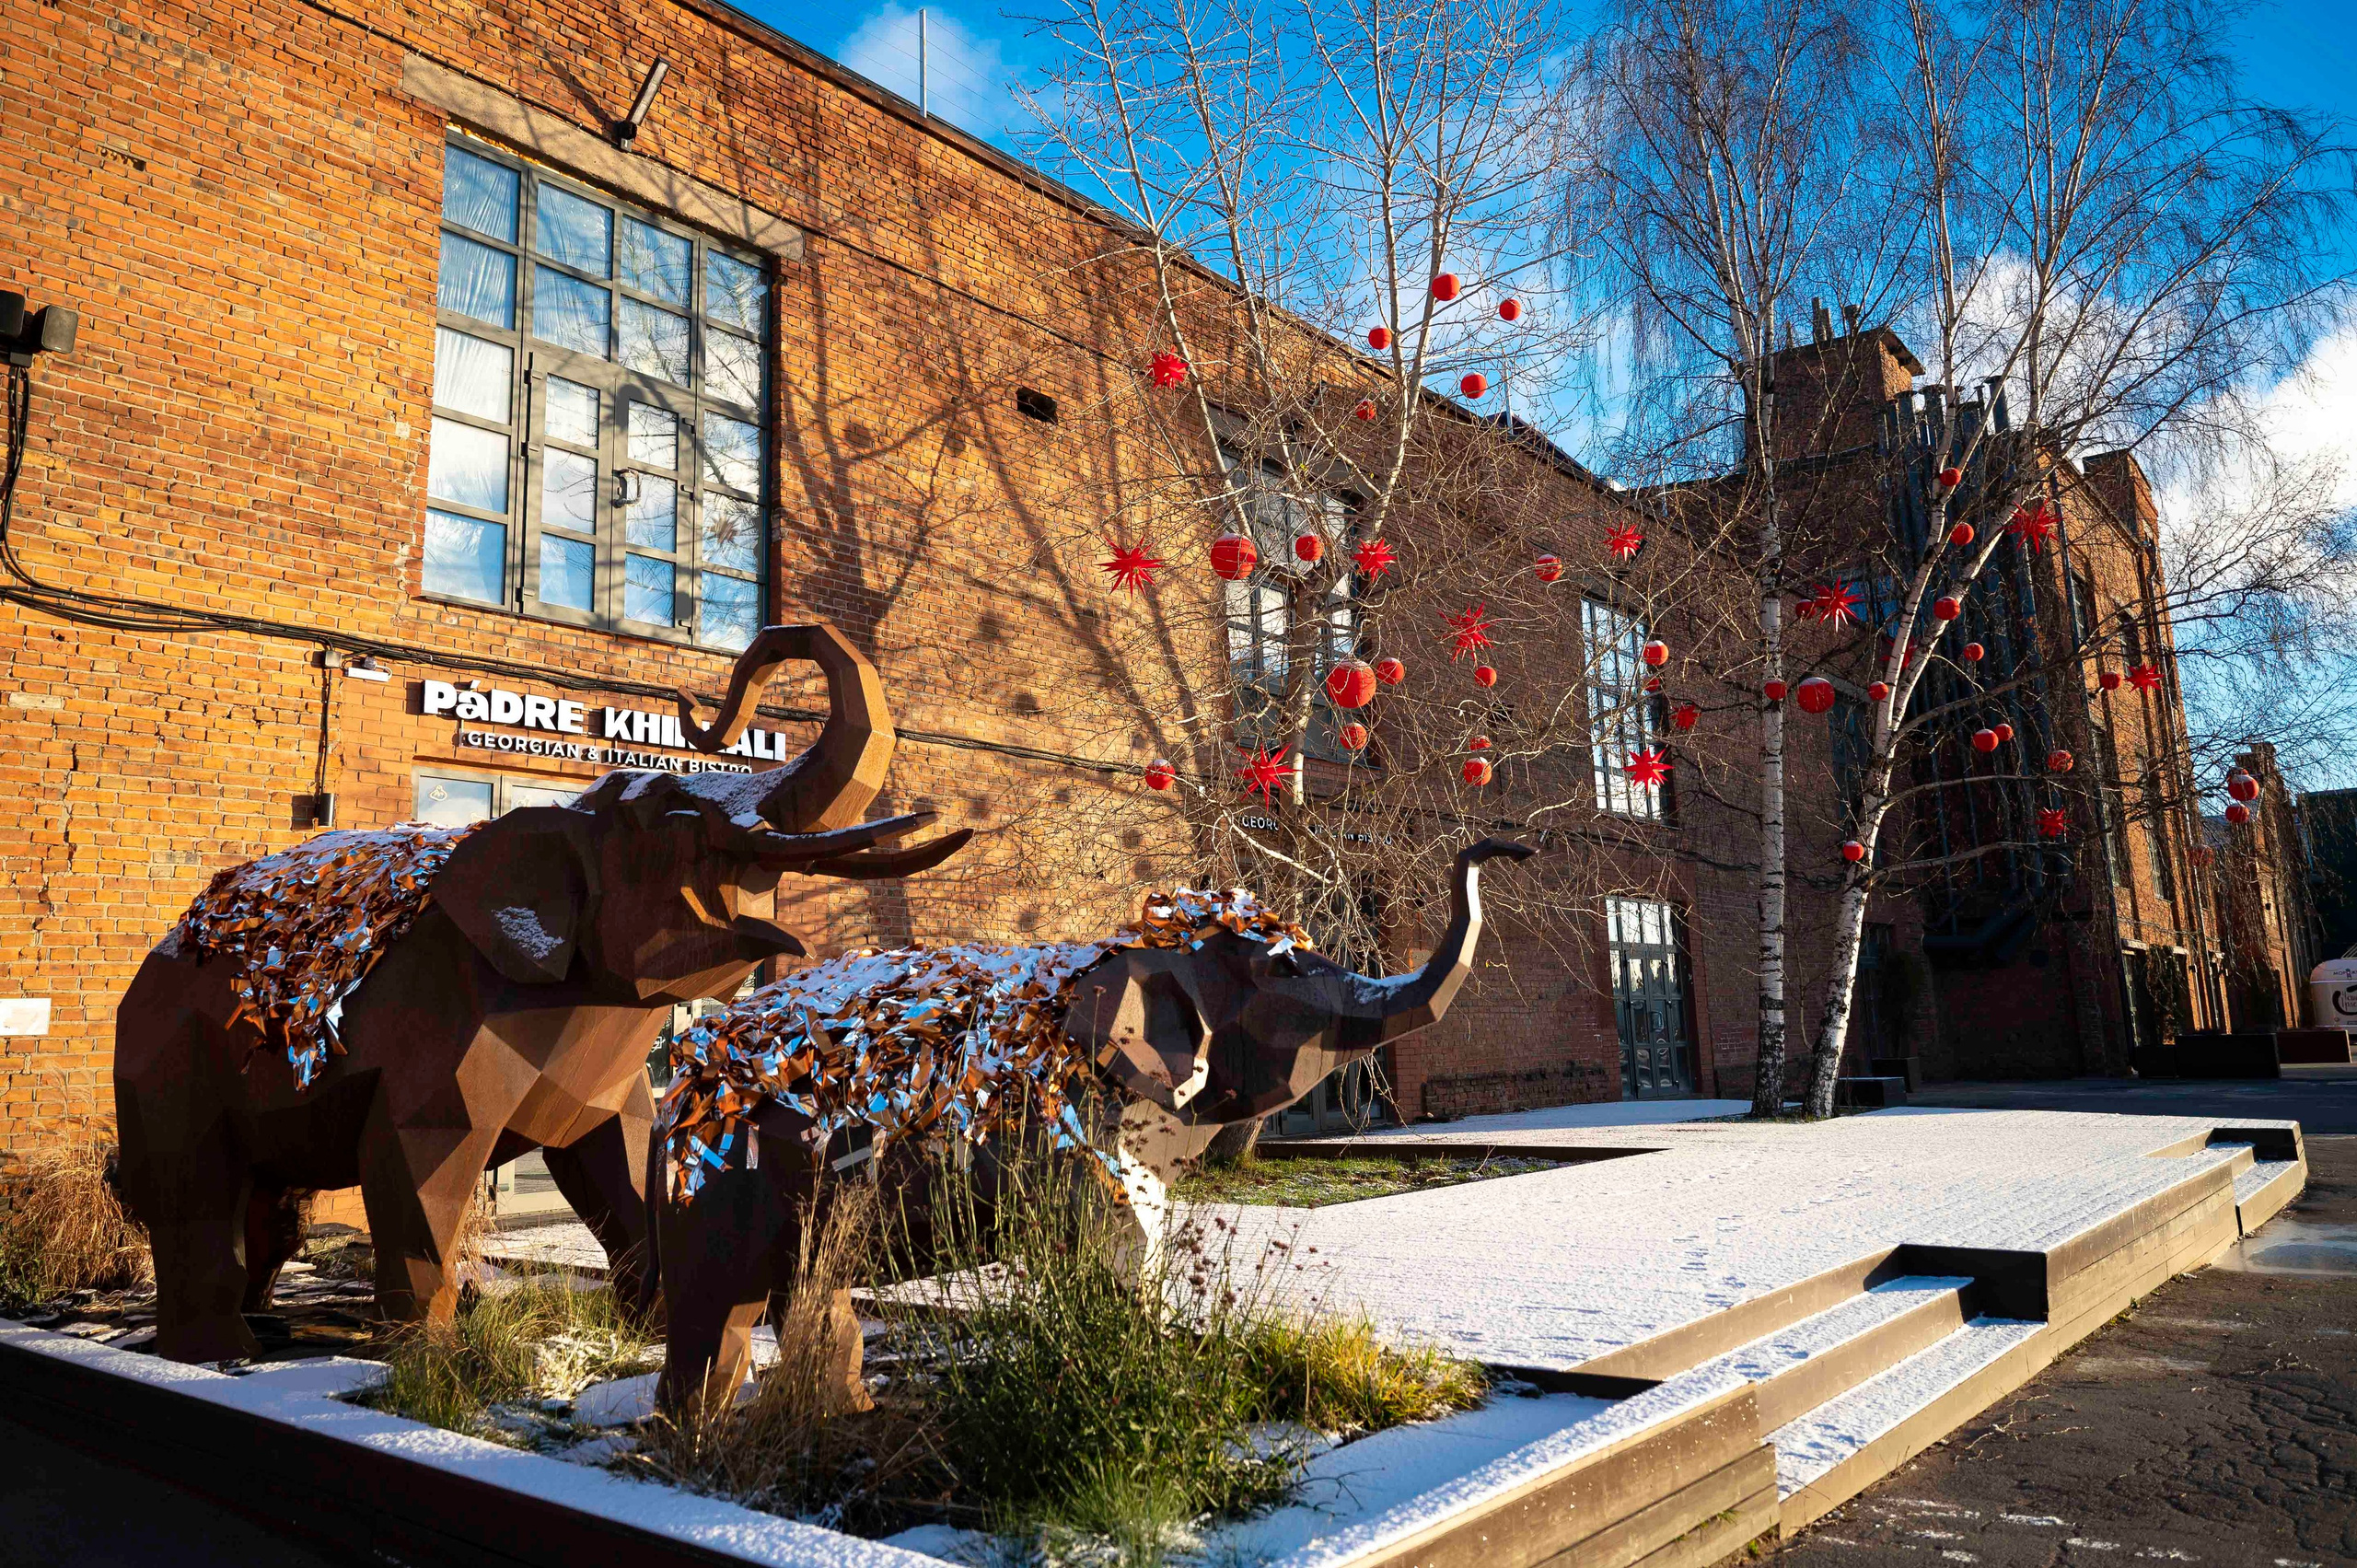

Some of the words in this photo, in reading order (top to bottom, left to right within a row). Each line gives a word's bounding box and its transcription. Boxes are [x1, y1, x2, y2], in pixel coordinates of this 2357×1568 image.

[468, 730, 579, 758] GEORGIAN
[587, 745, 598, 761] &
[608, 749, 680, 771] ITALIAN
[690, 759, 751, 774] BISTRO
[605, 706, 785, 761] KHIALI
